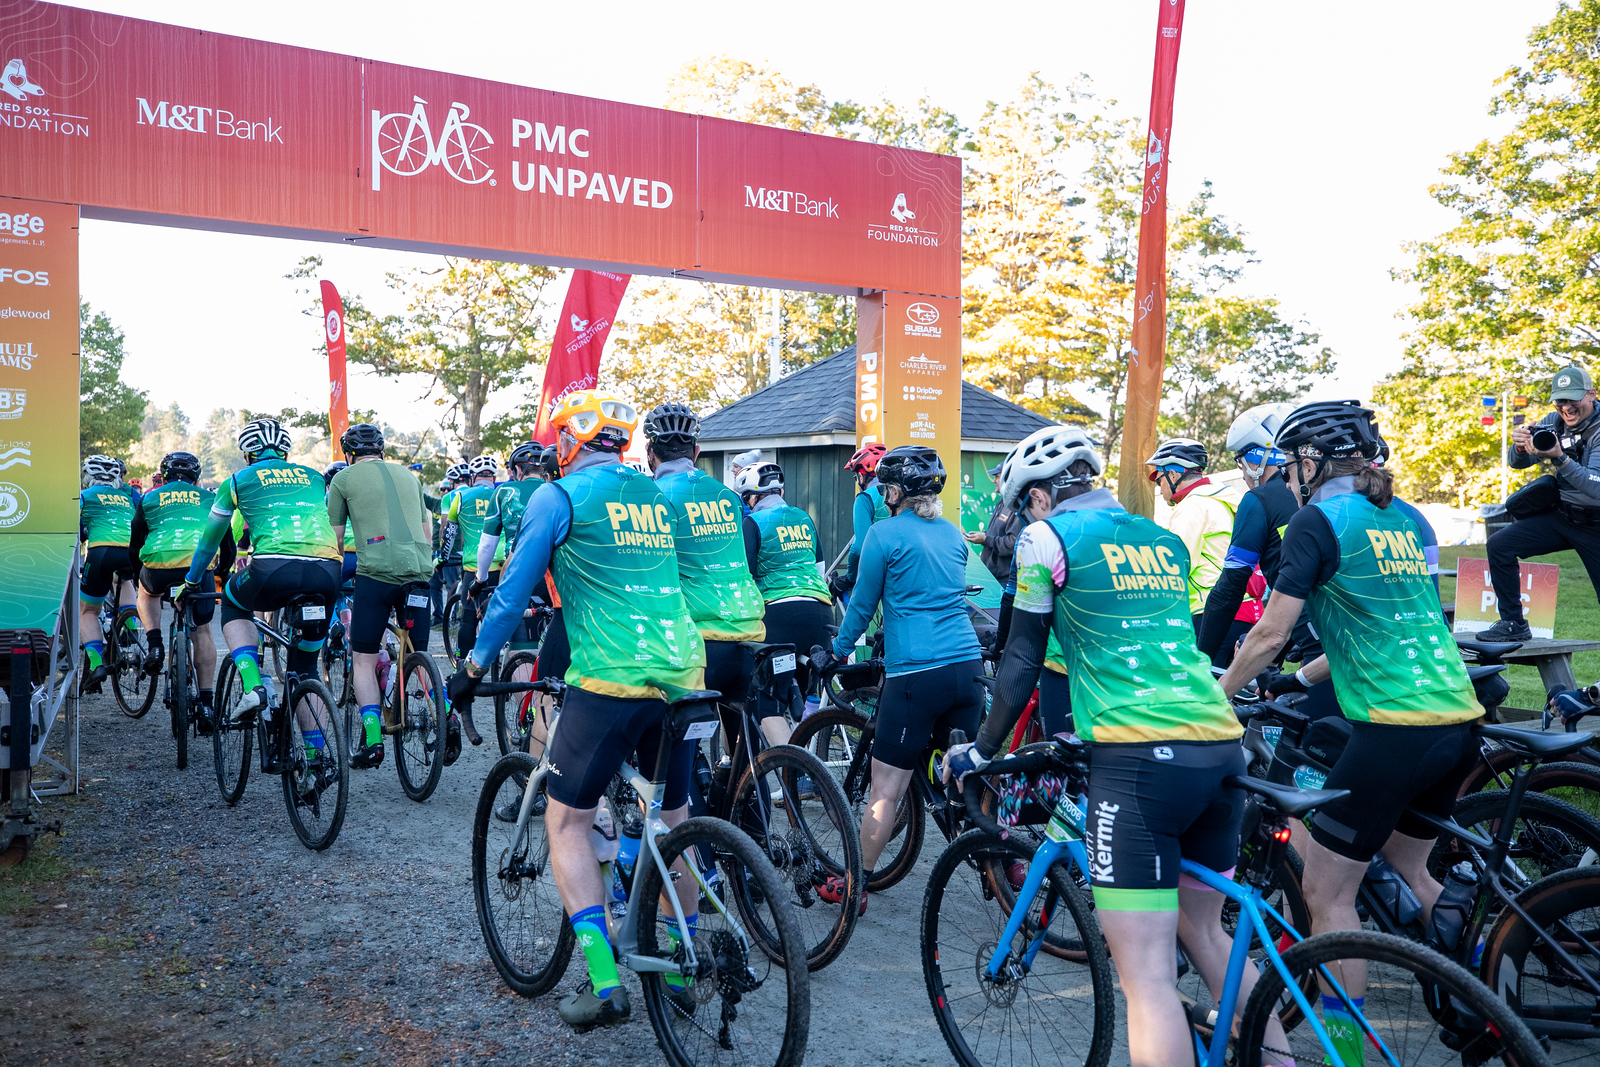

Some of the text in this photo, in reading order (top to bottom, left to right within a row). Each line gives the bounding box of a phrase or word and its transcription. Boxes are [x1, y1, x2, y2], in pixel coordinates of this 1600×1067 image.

[25, 106, 50, 117] SOX
[136, 97, 284, 144] M&T Bank
[512, 118, 590, 158] PMC
[512, 160, 674, 210] UNPAVED
[744, 185, 840, 219] M&T Bank
[890, 224, 918, 234] RED SOX
[868, 229, 938, 248] FOUNDATION
[0, 306, 50, 320] glewood
[566, 320, 609, 354] FOUNDATION
[904, 324, 942, 334] SUBARU
[900, 362, 928, 370] CHARLES
[570, 372, 596, 392] Bank
[861, 352, 878, 422] PMC
[916, 386, 943, 396] DripDrop
[910, 420, 936, 430] NON-ALC
[256, 468, 308, 480] PMC
[261, 478, 311, 486] UNPAVED
[97, 494, 130, 504] PMC
[159, 491, 200, 501] PMC
[160, 498, 200, 506] UNPAVED
[476, 498, 490, 510] PM
[606, 502, 671, 534] PMC
[684, 499, 734, 525] PMC
[691, 522, 738, 536] UNPAVED
[776, 524, 811, 542] PMC
[614, 532, 674, 548] UNPAVED
[781, 541, 812, 551] UNPAVED
[1366, 529, 1424, 560] PMC
[1100, 544, 1180, 575] PMC
[1112, 575, 1185, 592] UNPAVED
[1481, 590, 1530, 616] PC
[1096, 800, 1120, 883] Kermit
